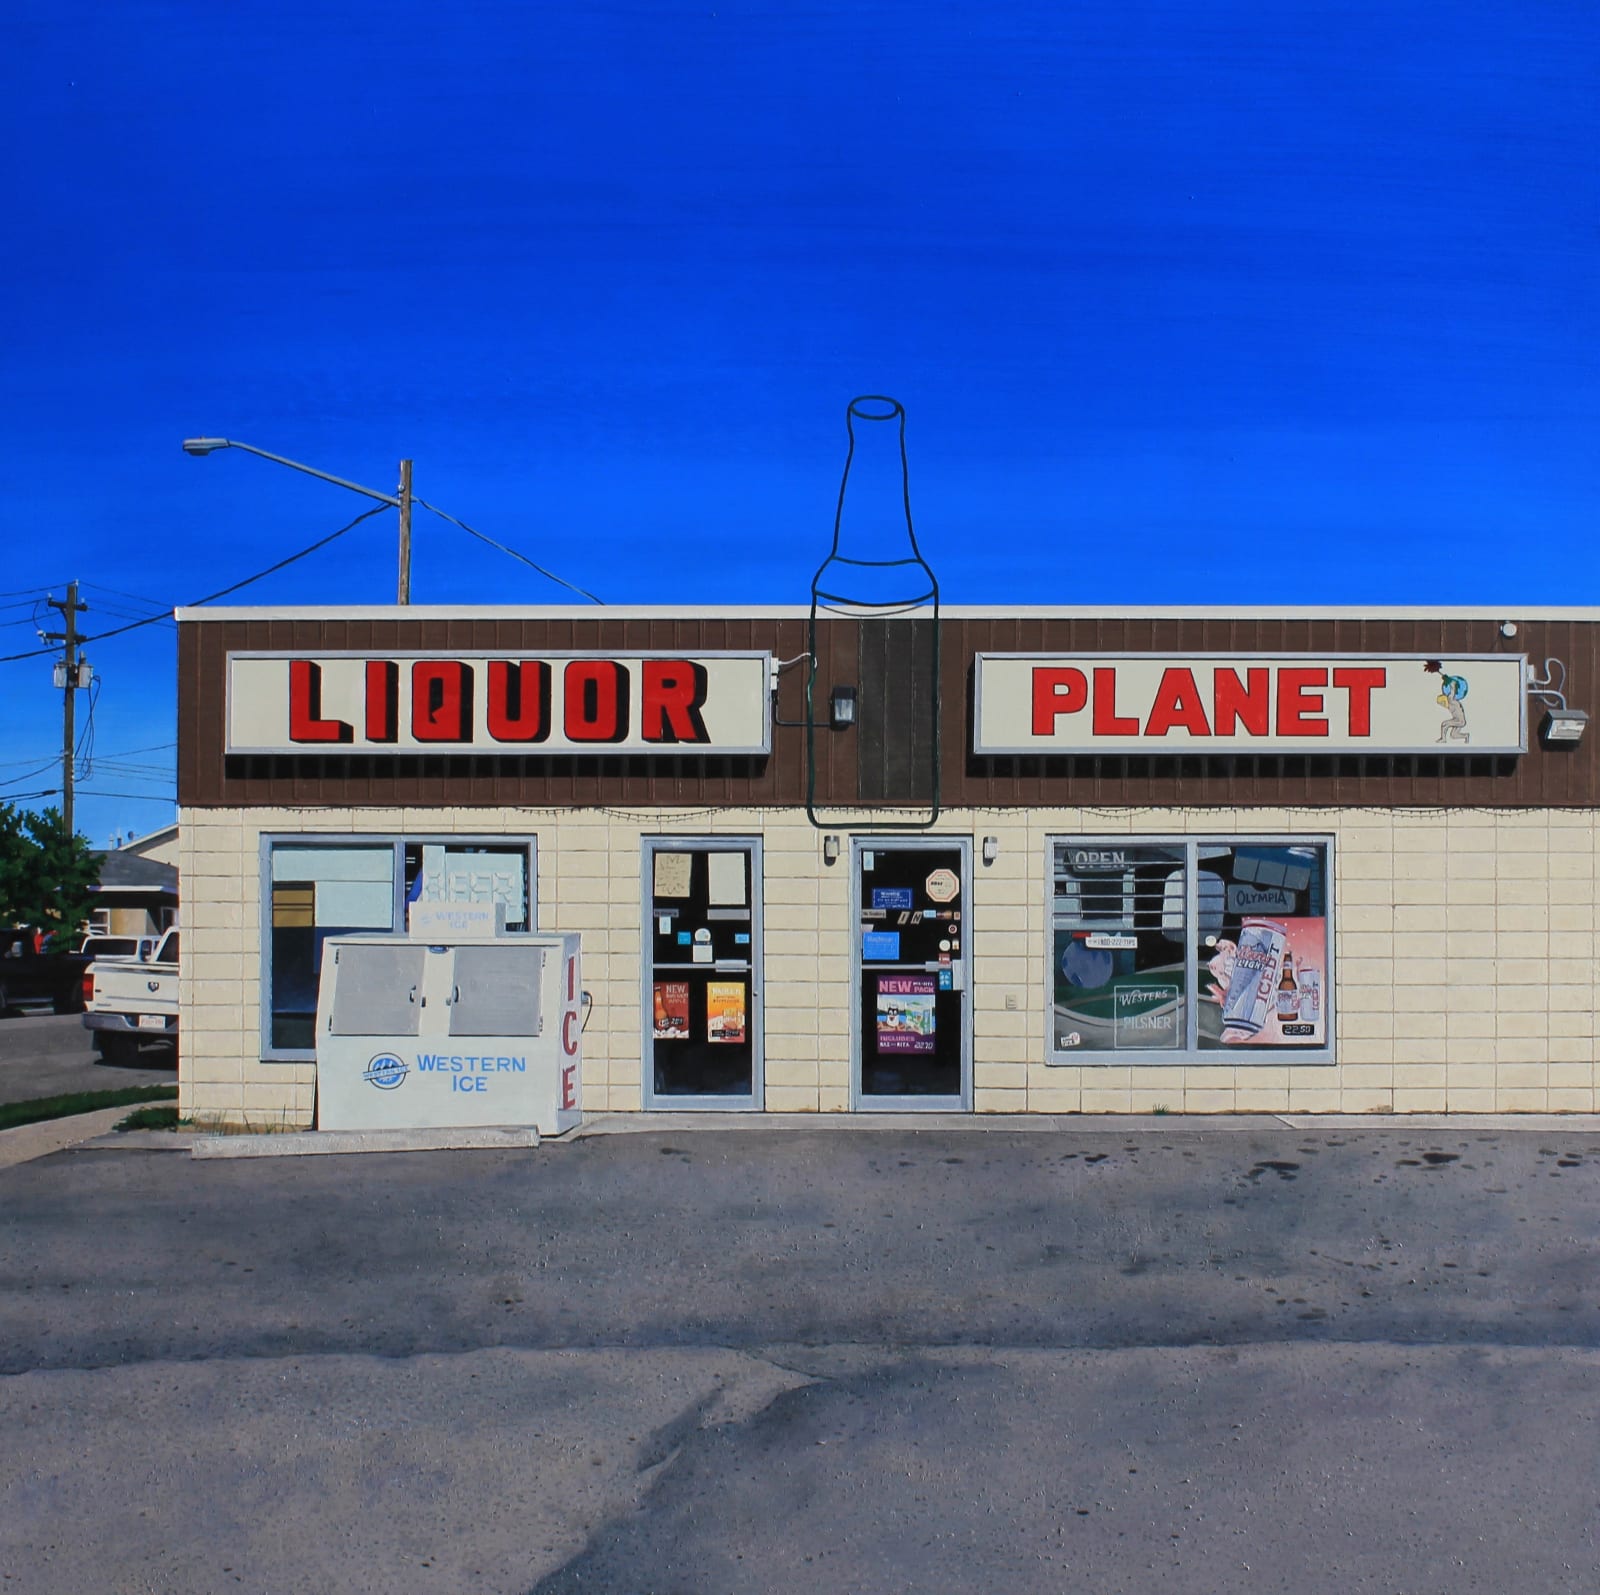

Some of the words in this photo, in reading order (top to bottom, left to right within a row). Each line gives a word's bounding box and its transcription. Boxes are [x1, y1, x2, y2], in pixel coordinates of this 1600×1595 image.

[289, 660, 710, 743] LIQUOR
[1032, 667, 1387, 737] PLANET
[1075, 850, 1126, 869] OPEN
[1236, 889, 1288, 906] OLYMPIA
[435, 911, 489, 921] WESTERN
[449, 920, 469, 929] ICE
[1237, 959, 1266, 971] LIGHT
[1256, 956, 1277, 1003] ICED
[1269, 943, 1280, 954] T
[666, 984, 685, 994] NEW
[880, 981, 912, 992] NEW
[1123, 1015, 1172, 1029] PILSNER
[562, 956, 577, 1110] ICE
[416, 1054, 526, 1072] WESTERN
[452, 1075, 488, 1092] ICE
